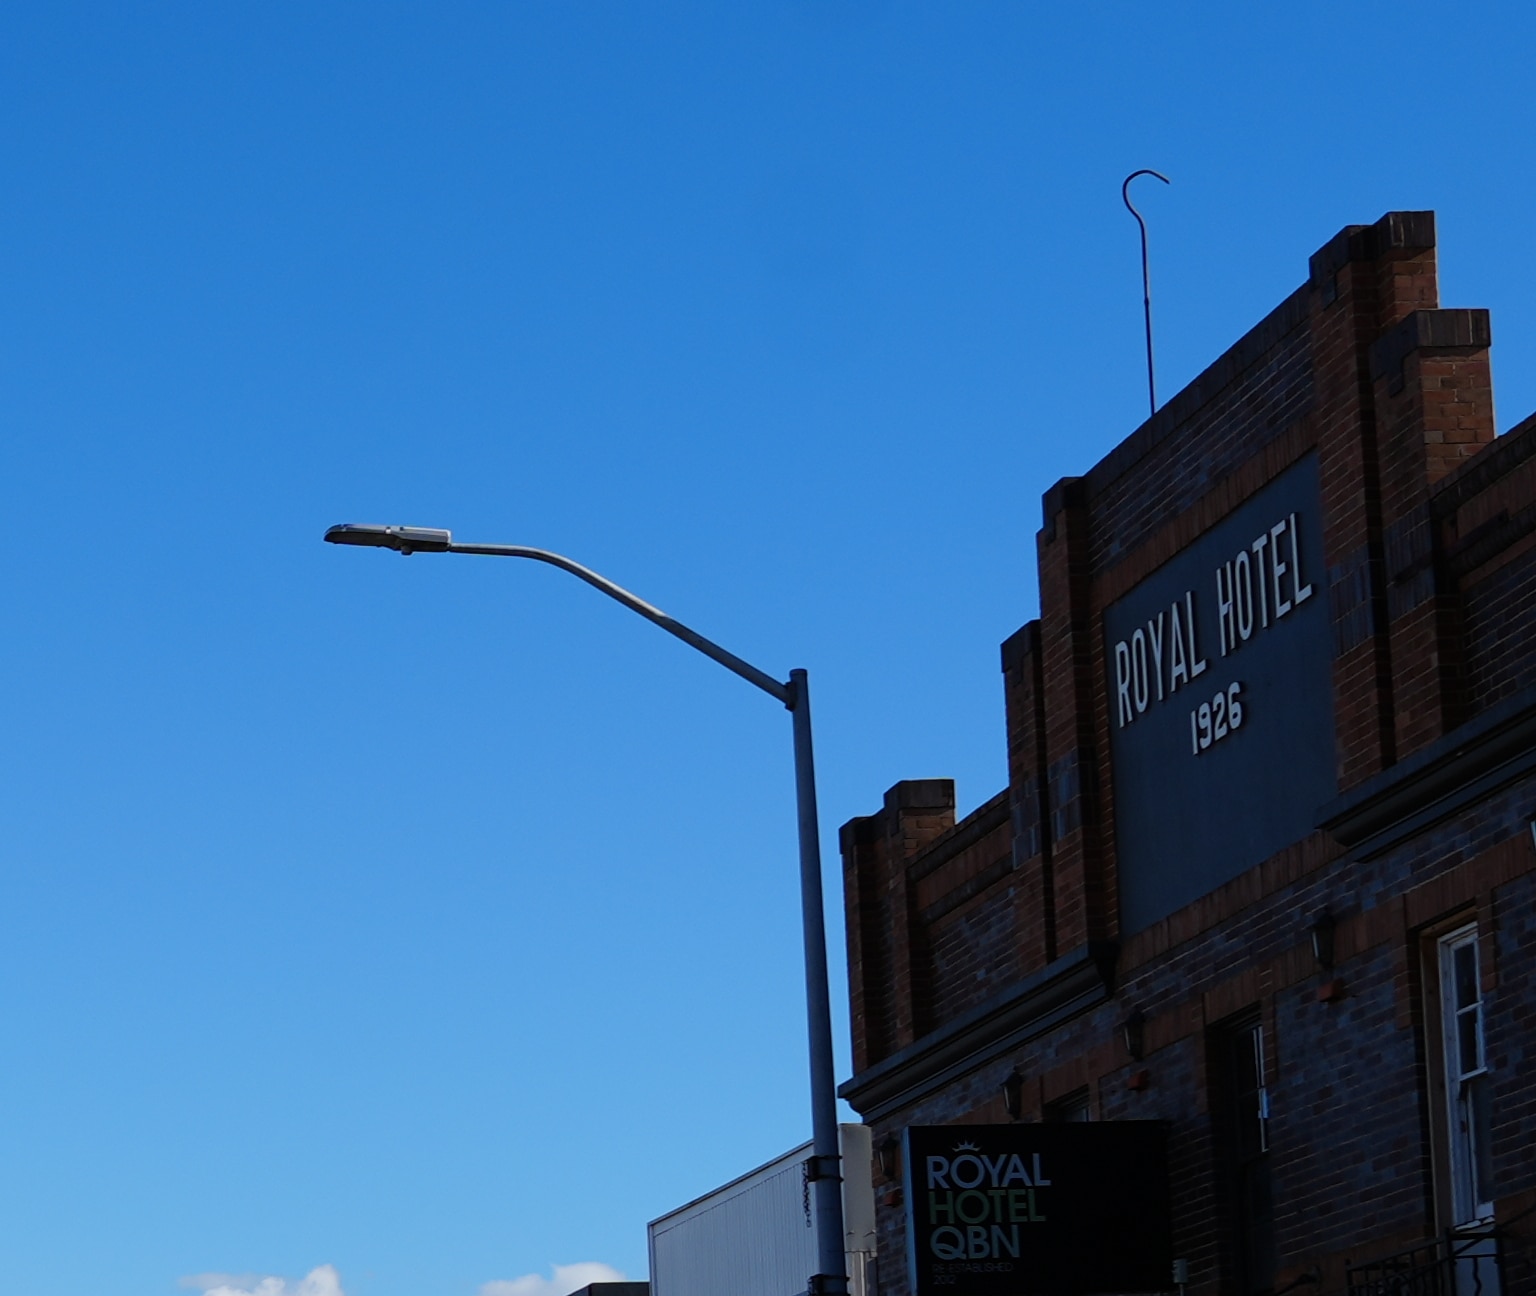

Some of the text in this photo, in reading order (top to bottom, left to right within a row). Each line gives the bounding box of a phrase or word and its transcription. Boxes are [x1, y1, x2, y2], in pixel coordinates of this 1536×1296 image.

[1115, 512, 1313, 728] ROYAL HOTEL
[1190, 681, 1243, 755] 1926
[925, 1152, 1052, 1190] ROYAL
[928, 1188, 1048, 1225] HOTEL
[929, 1224, 1023, 1261] QBN
